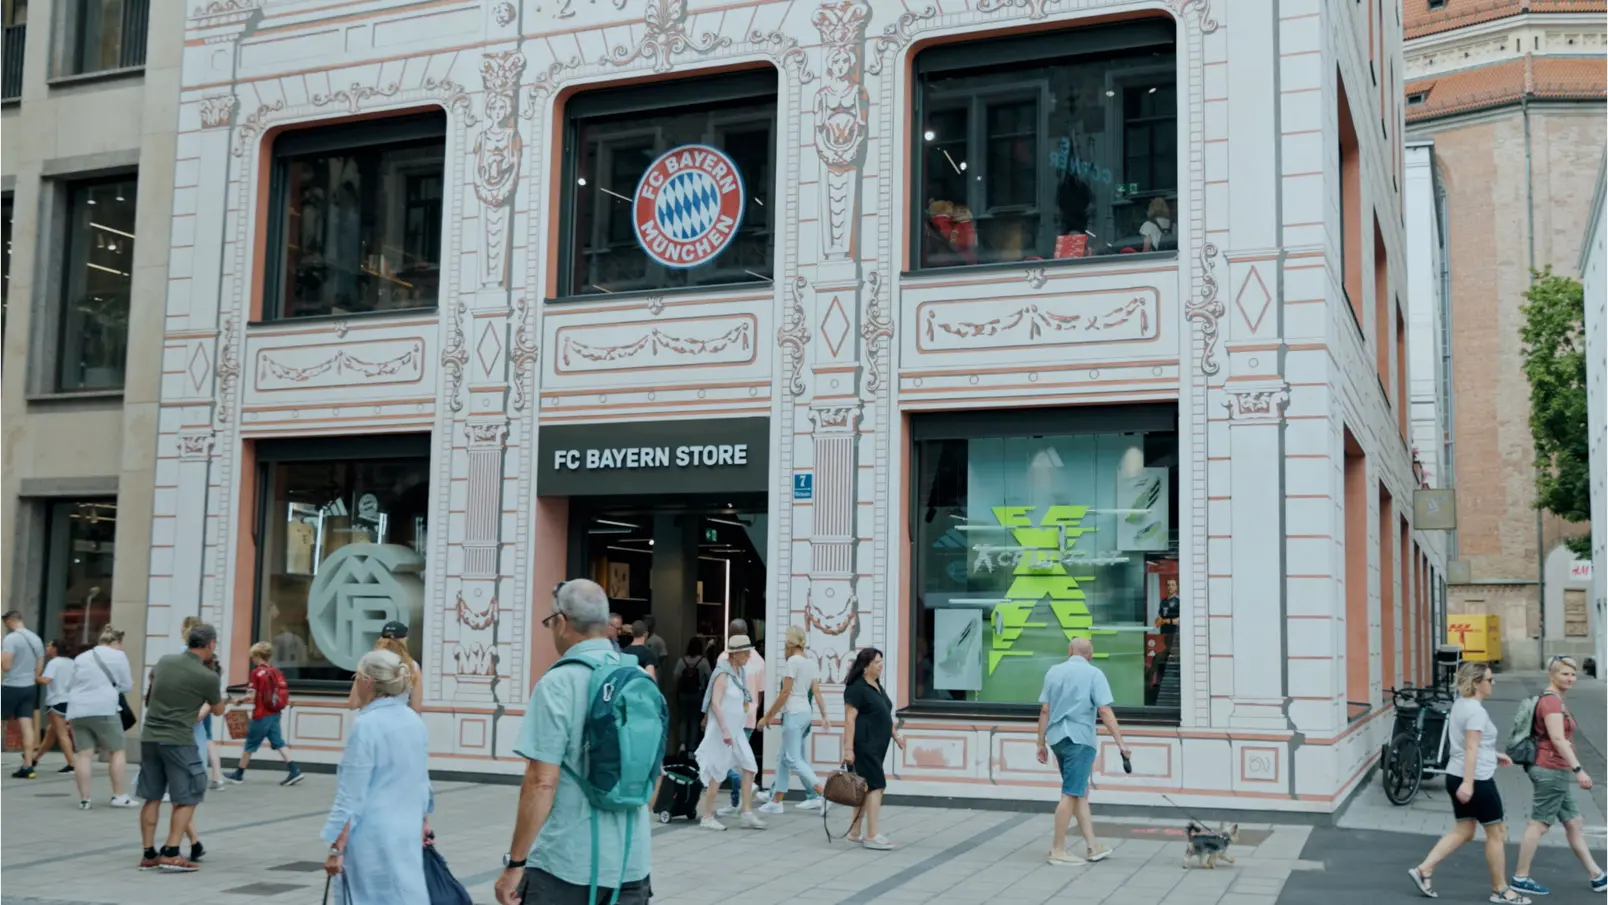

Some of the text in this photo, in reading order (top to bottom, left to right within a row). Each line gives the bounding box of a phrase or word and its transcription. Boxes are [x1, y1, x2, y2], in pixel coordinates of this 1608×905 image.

[641, 151, 736, 200] FC BAYERN
[640, 214, 734, 261] MÜNCHEN
[554, 444, 747, 470] FC BAYERN STORE
[799, 475, 807, 487] 7
